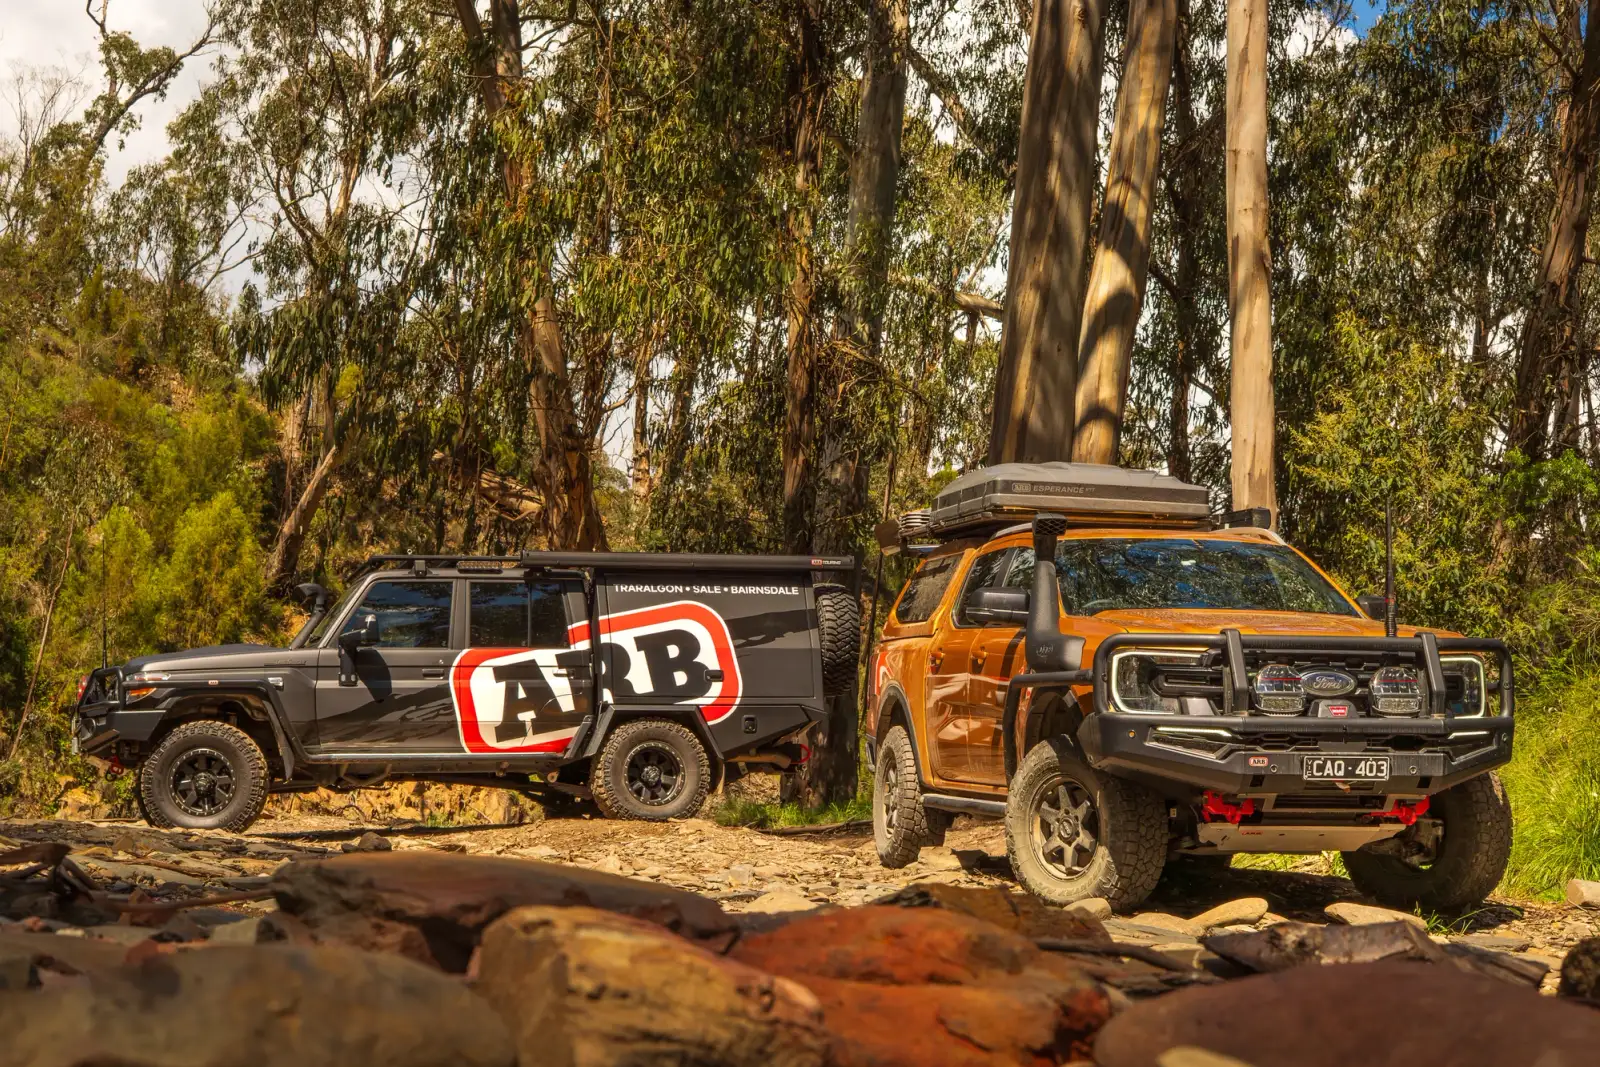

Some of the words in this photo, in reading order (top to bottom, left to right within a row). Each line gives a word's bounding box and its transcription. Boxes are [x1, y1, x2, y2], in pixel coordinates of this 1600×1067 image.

[1033, 485, 1084, 494] ESPERANCE
[613, 584, 683, 593] TRARALGON
[693, 585, 721, 594] SALE
[731, 586, 799, 595] BAIRNSDALE
[492, 629, 713, 743] ARB
[1313, 676, 1342, 690] Ford
